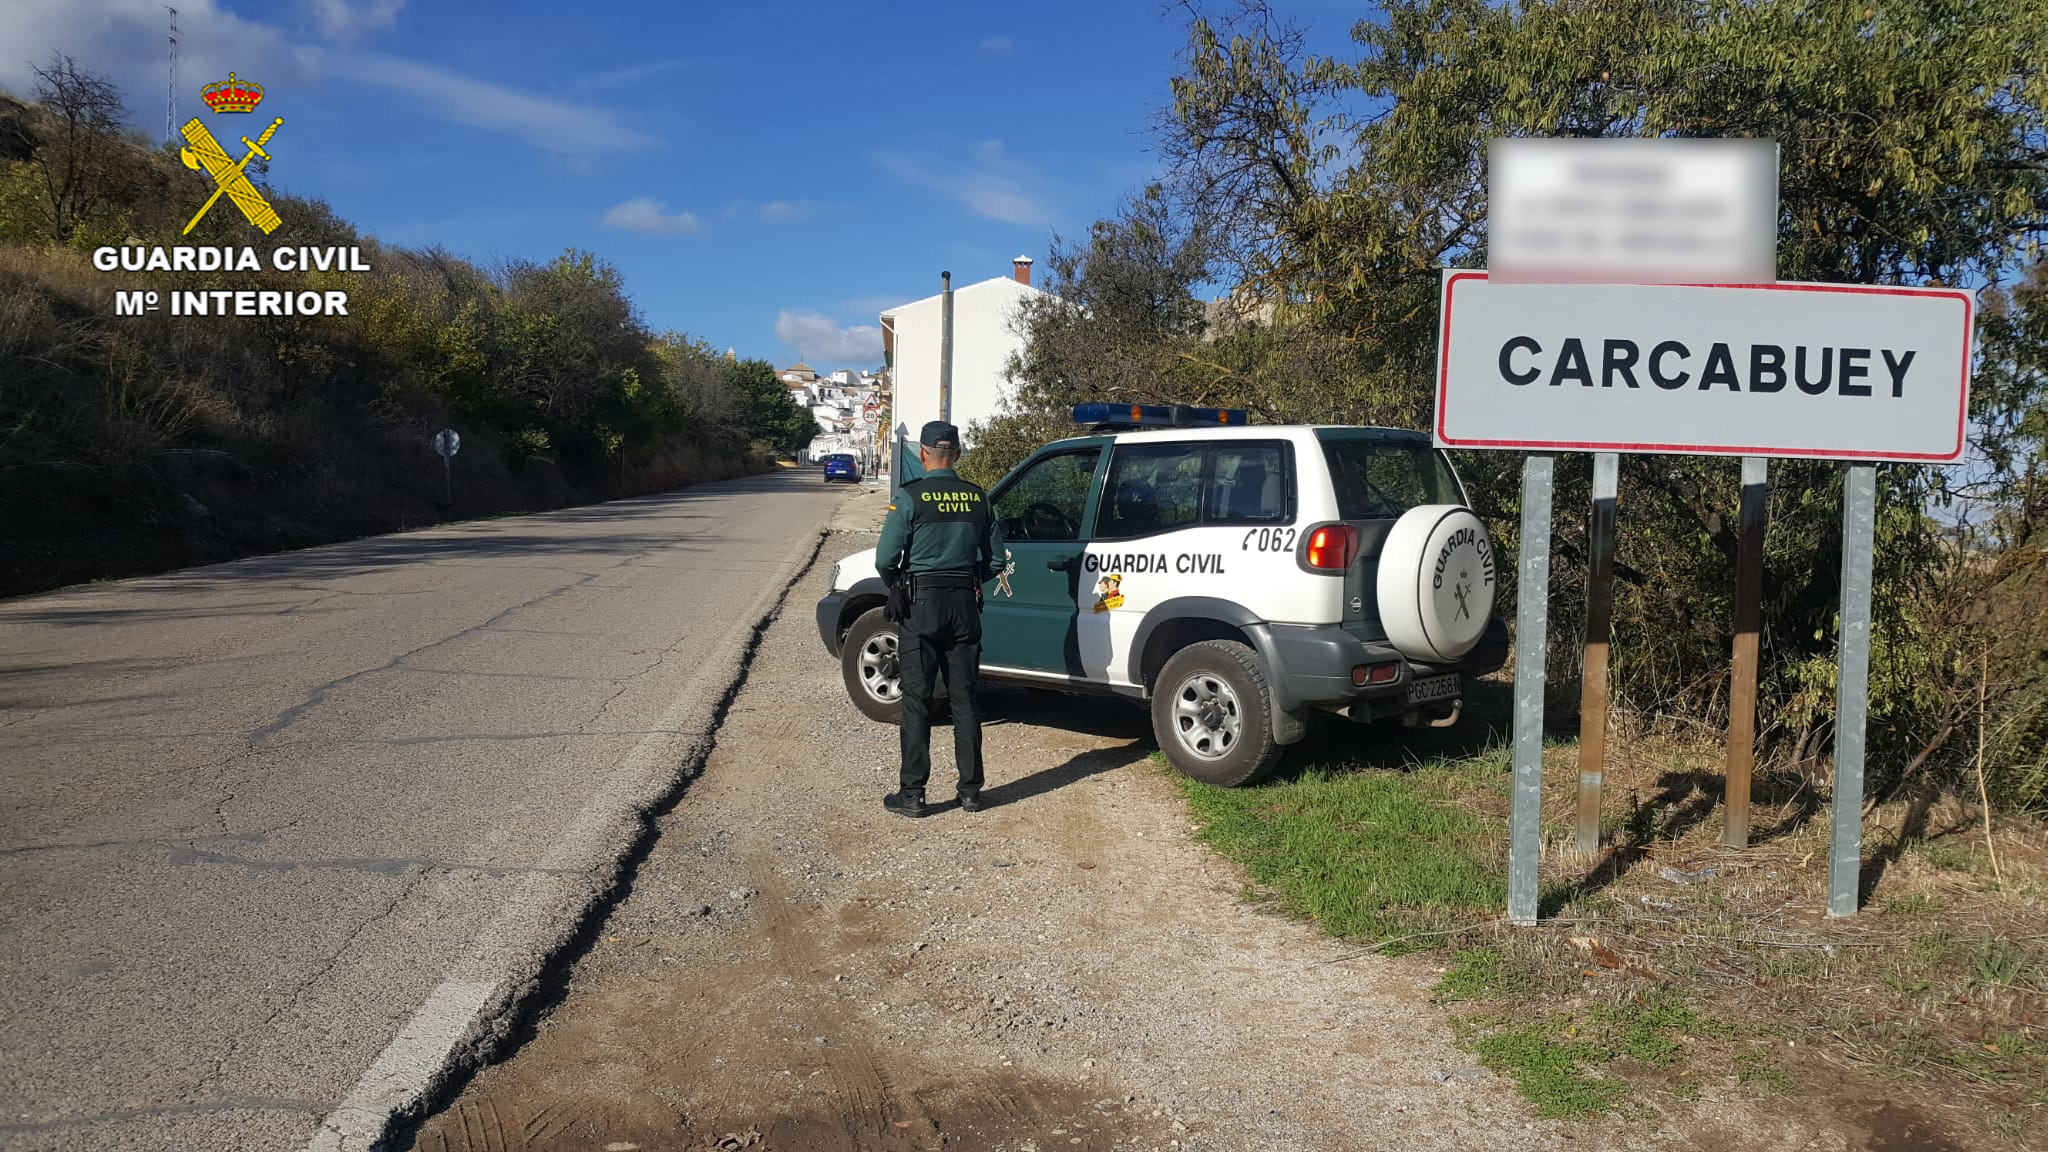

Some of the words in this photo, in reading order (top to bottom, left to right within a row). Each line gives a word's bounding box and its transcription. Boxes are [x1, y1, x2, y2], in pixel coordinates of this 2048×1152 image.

[1498, 335, 1917, 398] CARCABUEY
[921, 492, 981, 502] GUARDIA
[937, 502, 972, 512] CIVIL
[1258, 527, 1296, 552] 062
[1084, 553, 1168, 574] GUARDIA
[1175, 553, 1226, 574] CIVIL
[1432, 527, 1475, 590] GUARDIA
[1476, 538, 1494, 587] CIVIL
